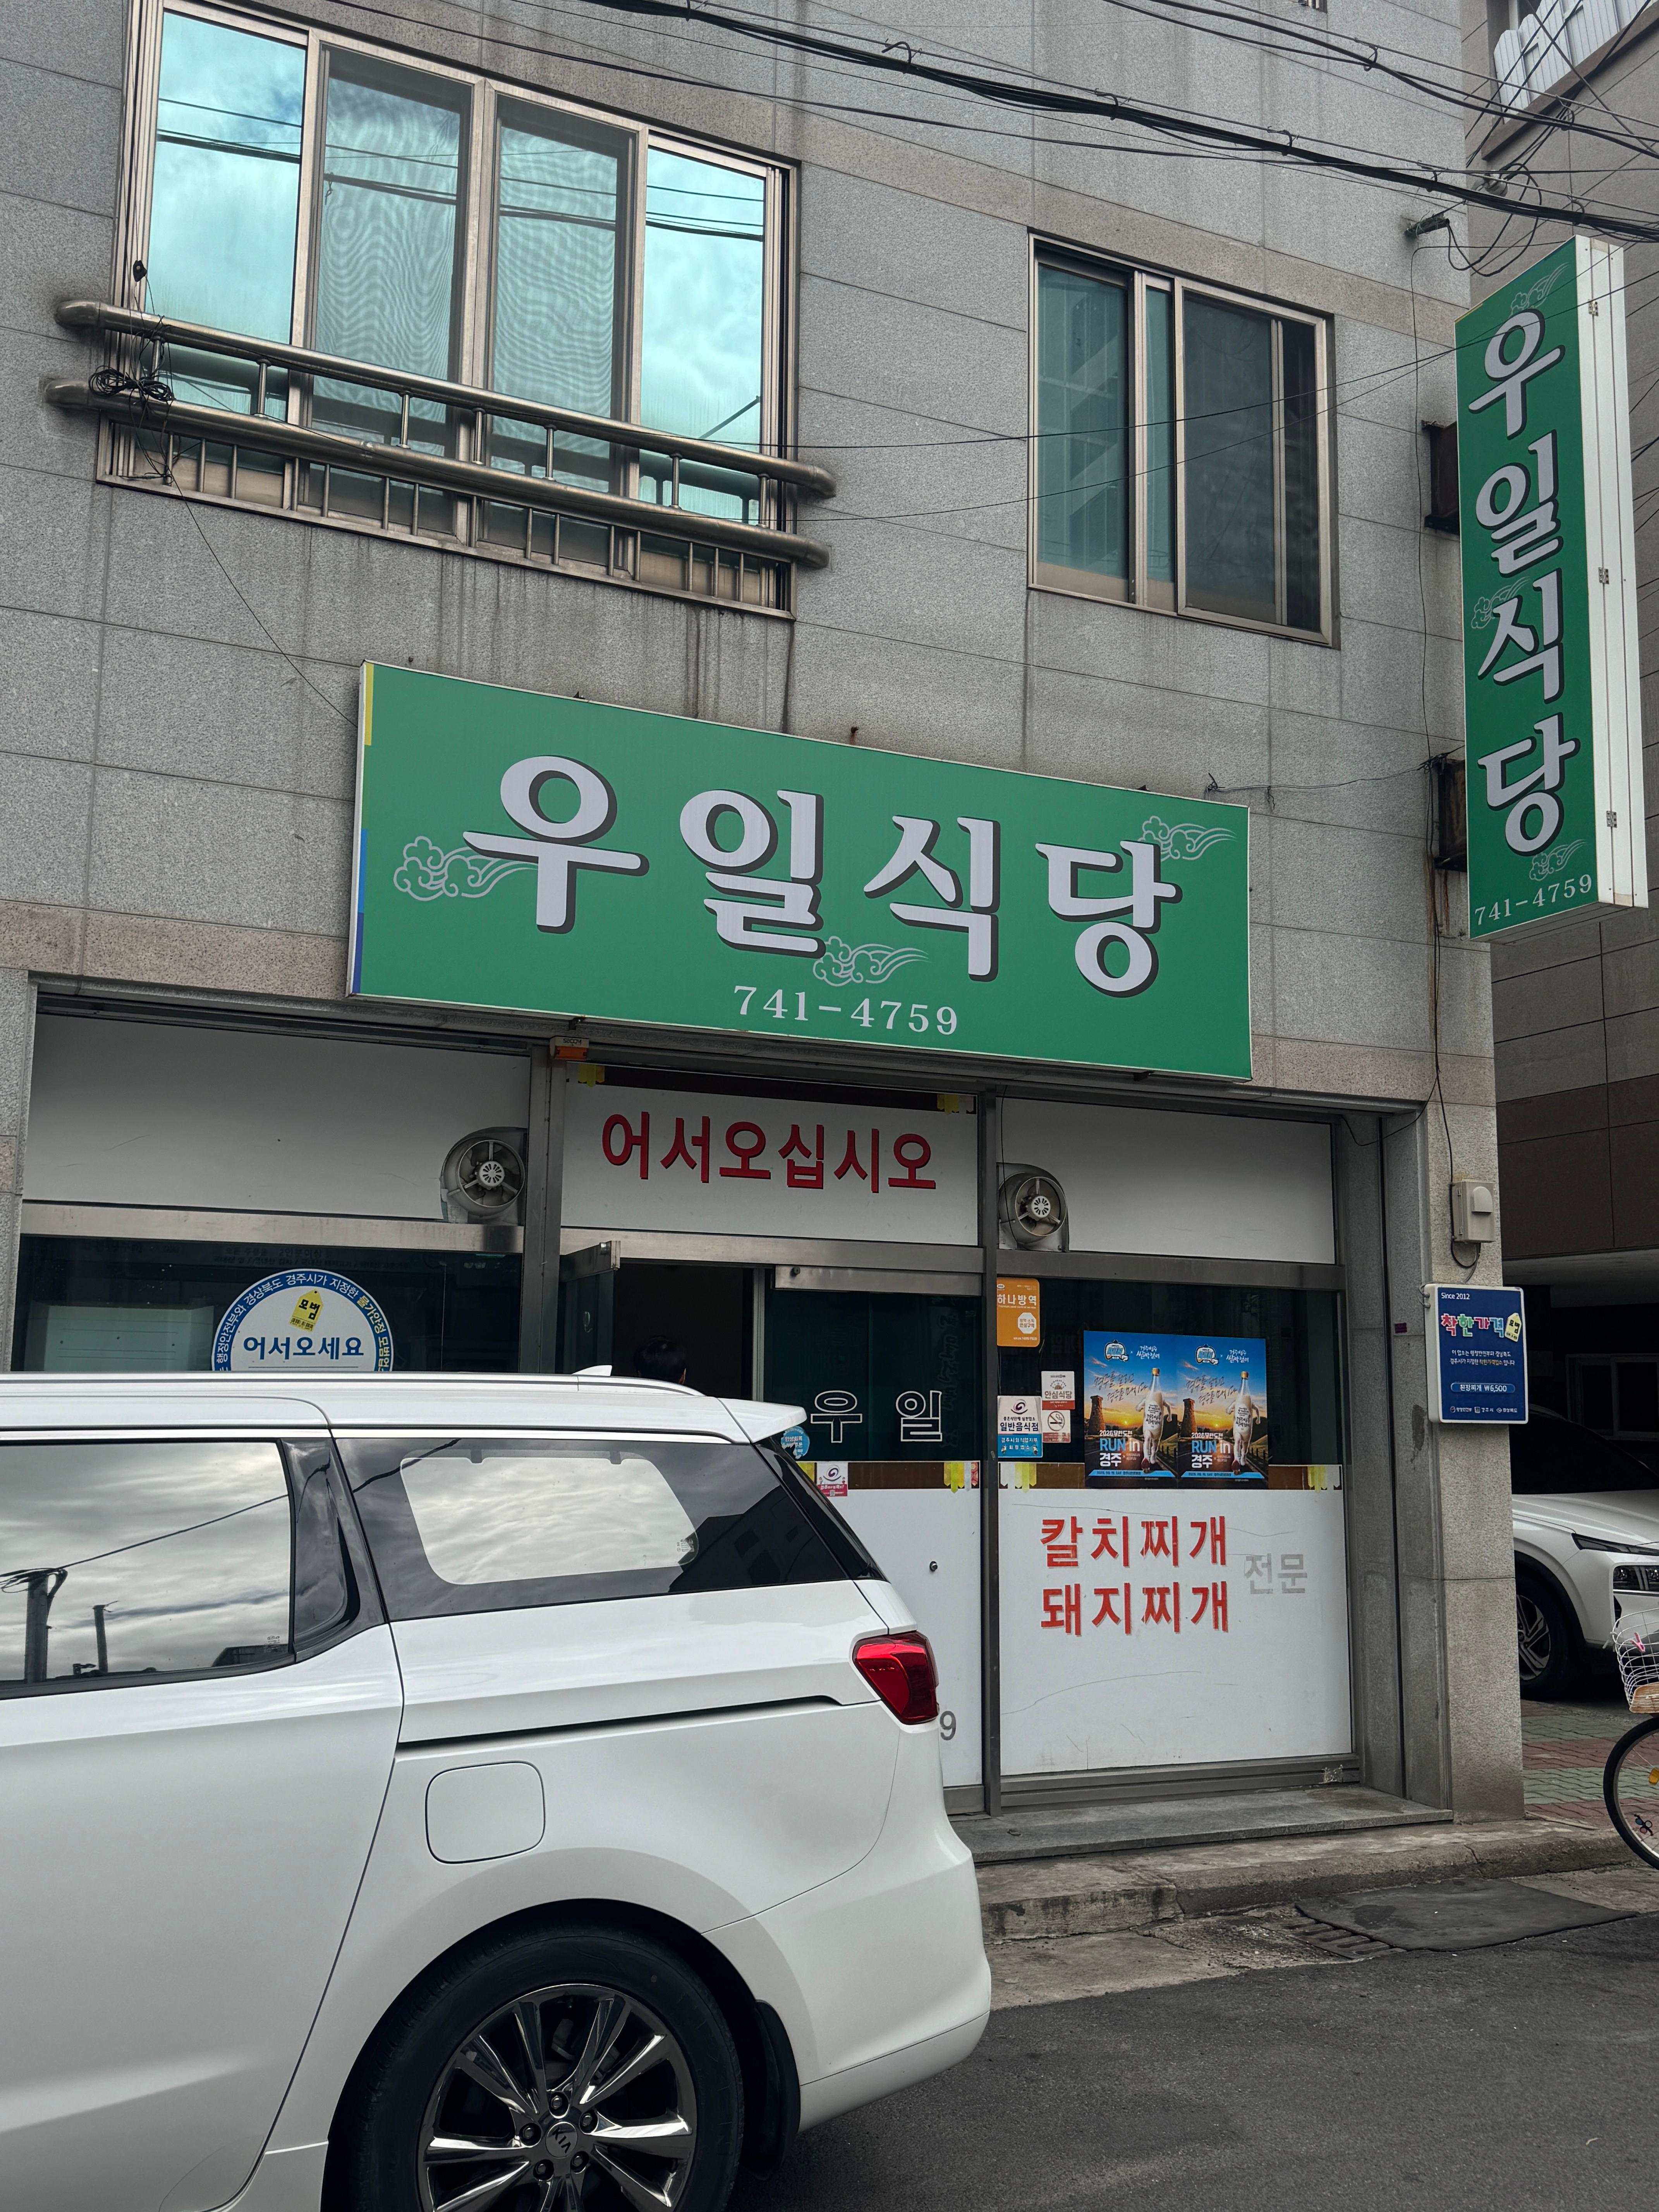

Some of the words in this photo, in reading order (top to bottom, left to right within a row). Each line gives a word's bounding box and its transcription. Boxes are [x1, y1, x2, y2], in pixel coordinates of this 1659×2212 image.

[1468, 309, 1581, 857] 우일식당
[463, 754, 1182, 998] 우일식당
[1474, 873, 1594, 927] 741-4759
[733, 985, 958, 1035] 741-4759
[602, 1111, 936, 1194] 어서오십시오
[299, 1298, 321, 1321] 모범
[997, 1293, 1037, 1306] 하나방역
[216, 1304, 247, 1364] 행정안전부와
[244, 1278, 283, 1306] 경상북도
[285, 1273, 328, 1286] 경주시가
[329, 1278, 359, 1300] 지정한
[356, 1295, 387, 1334] 물가안정
[1441, 1313, 1504, 1338] 착한가격
[243, 1337, 364, 1360] 어서오세요
[1044, 1391, 1072, 1399] 안심식당
[1000, 1422, 1039, 1432] 일반음식점
[1099, 1438, 1127, 1452] RUN
[1129, 1437, 1140, 1452] in
[1192, 1439, 1217, 1454] RUN
[1219, 1439, 1231, 1454] in
[1099, 1452, 1122, 1467] 경주
[1191, 1454, 1213, 1469] 경주
[1041, 1515, 1228, 1568] 칼치찌개
[1243, 1553, 1308, 1595] 전문
[1041, 1580, 1229, 1637] 돼지찌개
[551, 2127, 571, 2154] KIA
